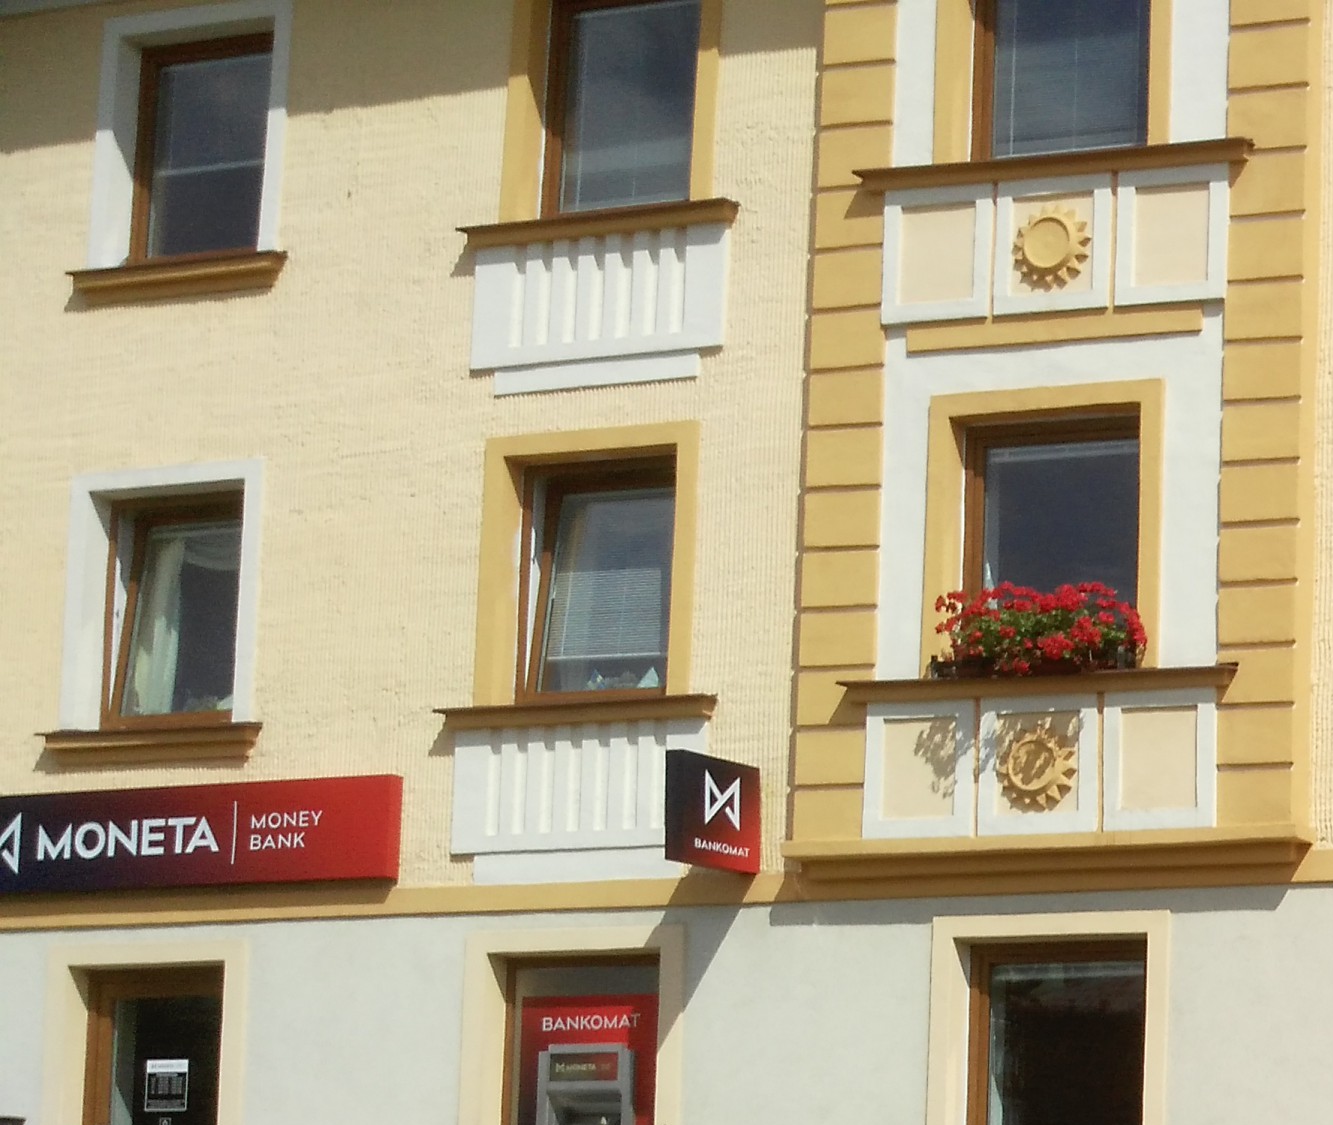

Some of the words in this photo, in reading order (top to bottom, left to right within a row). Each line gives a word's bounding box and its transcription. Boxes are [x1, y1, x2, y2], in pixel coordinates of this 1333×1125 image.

[251, 810, 323, 830] MONEY
[37, 816, 219, 861] MONETA
[249, 832, 305, 851] BANK
[694, 837, 750, 858] BANKOMAT
[542, 1013, 640, 1032] BANKOMAT
